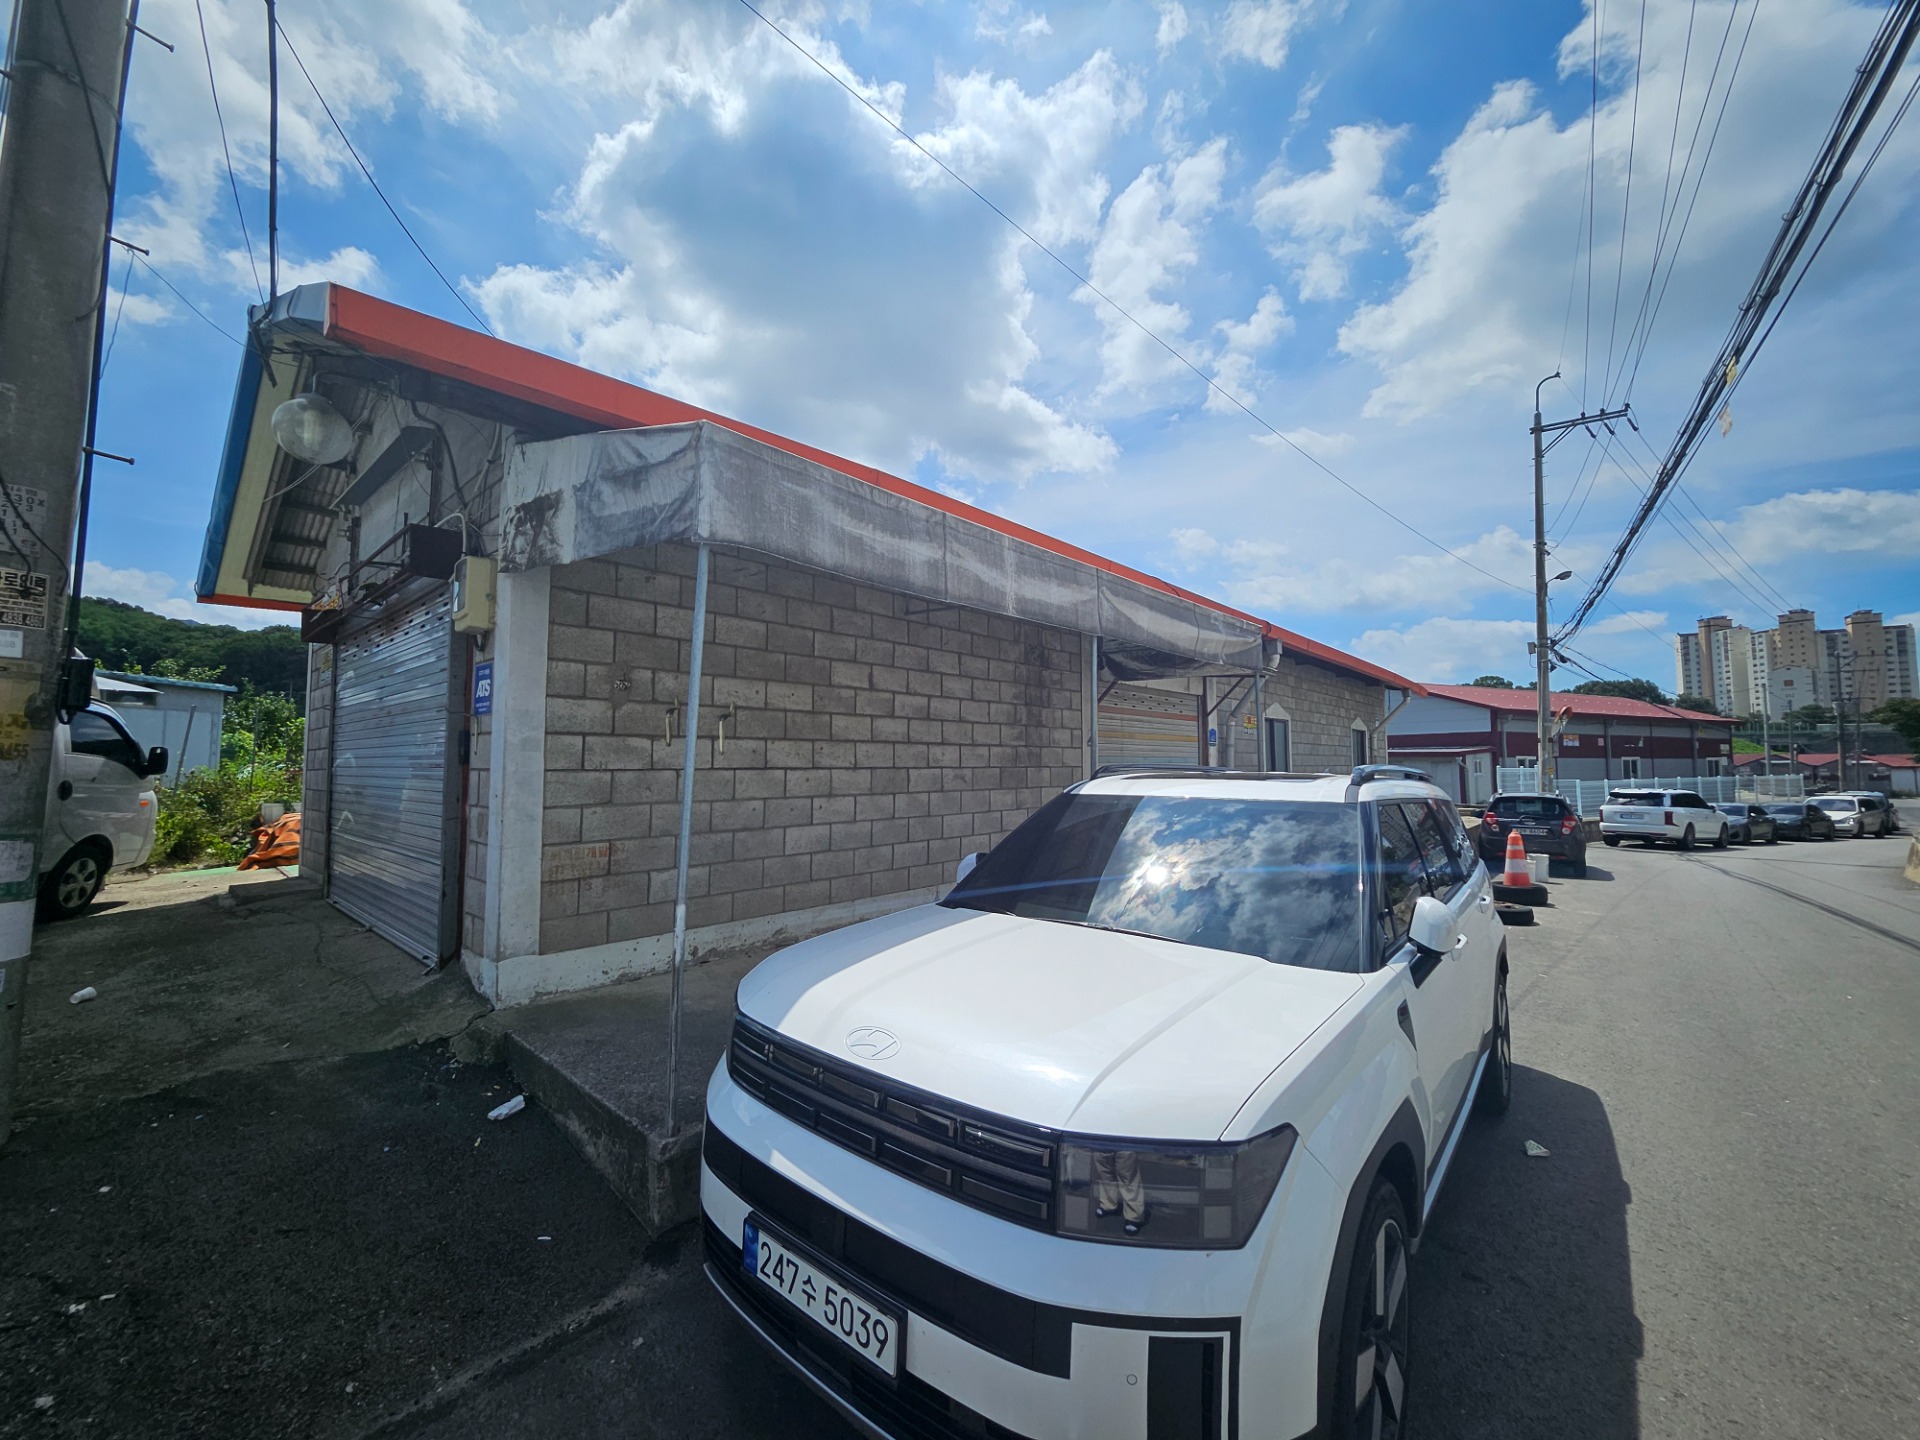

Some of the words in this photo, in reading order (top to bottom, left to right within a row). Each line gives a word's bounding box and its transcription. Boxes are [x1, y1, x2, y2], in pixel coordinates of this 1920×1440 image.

[0, 571, 46, 591] 로인력
[475, 679, 491, 698] ATS
[760, 1241, 817, 1307] 247수
[824, 1285, 889, 1358] 5039
